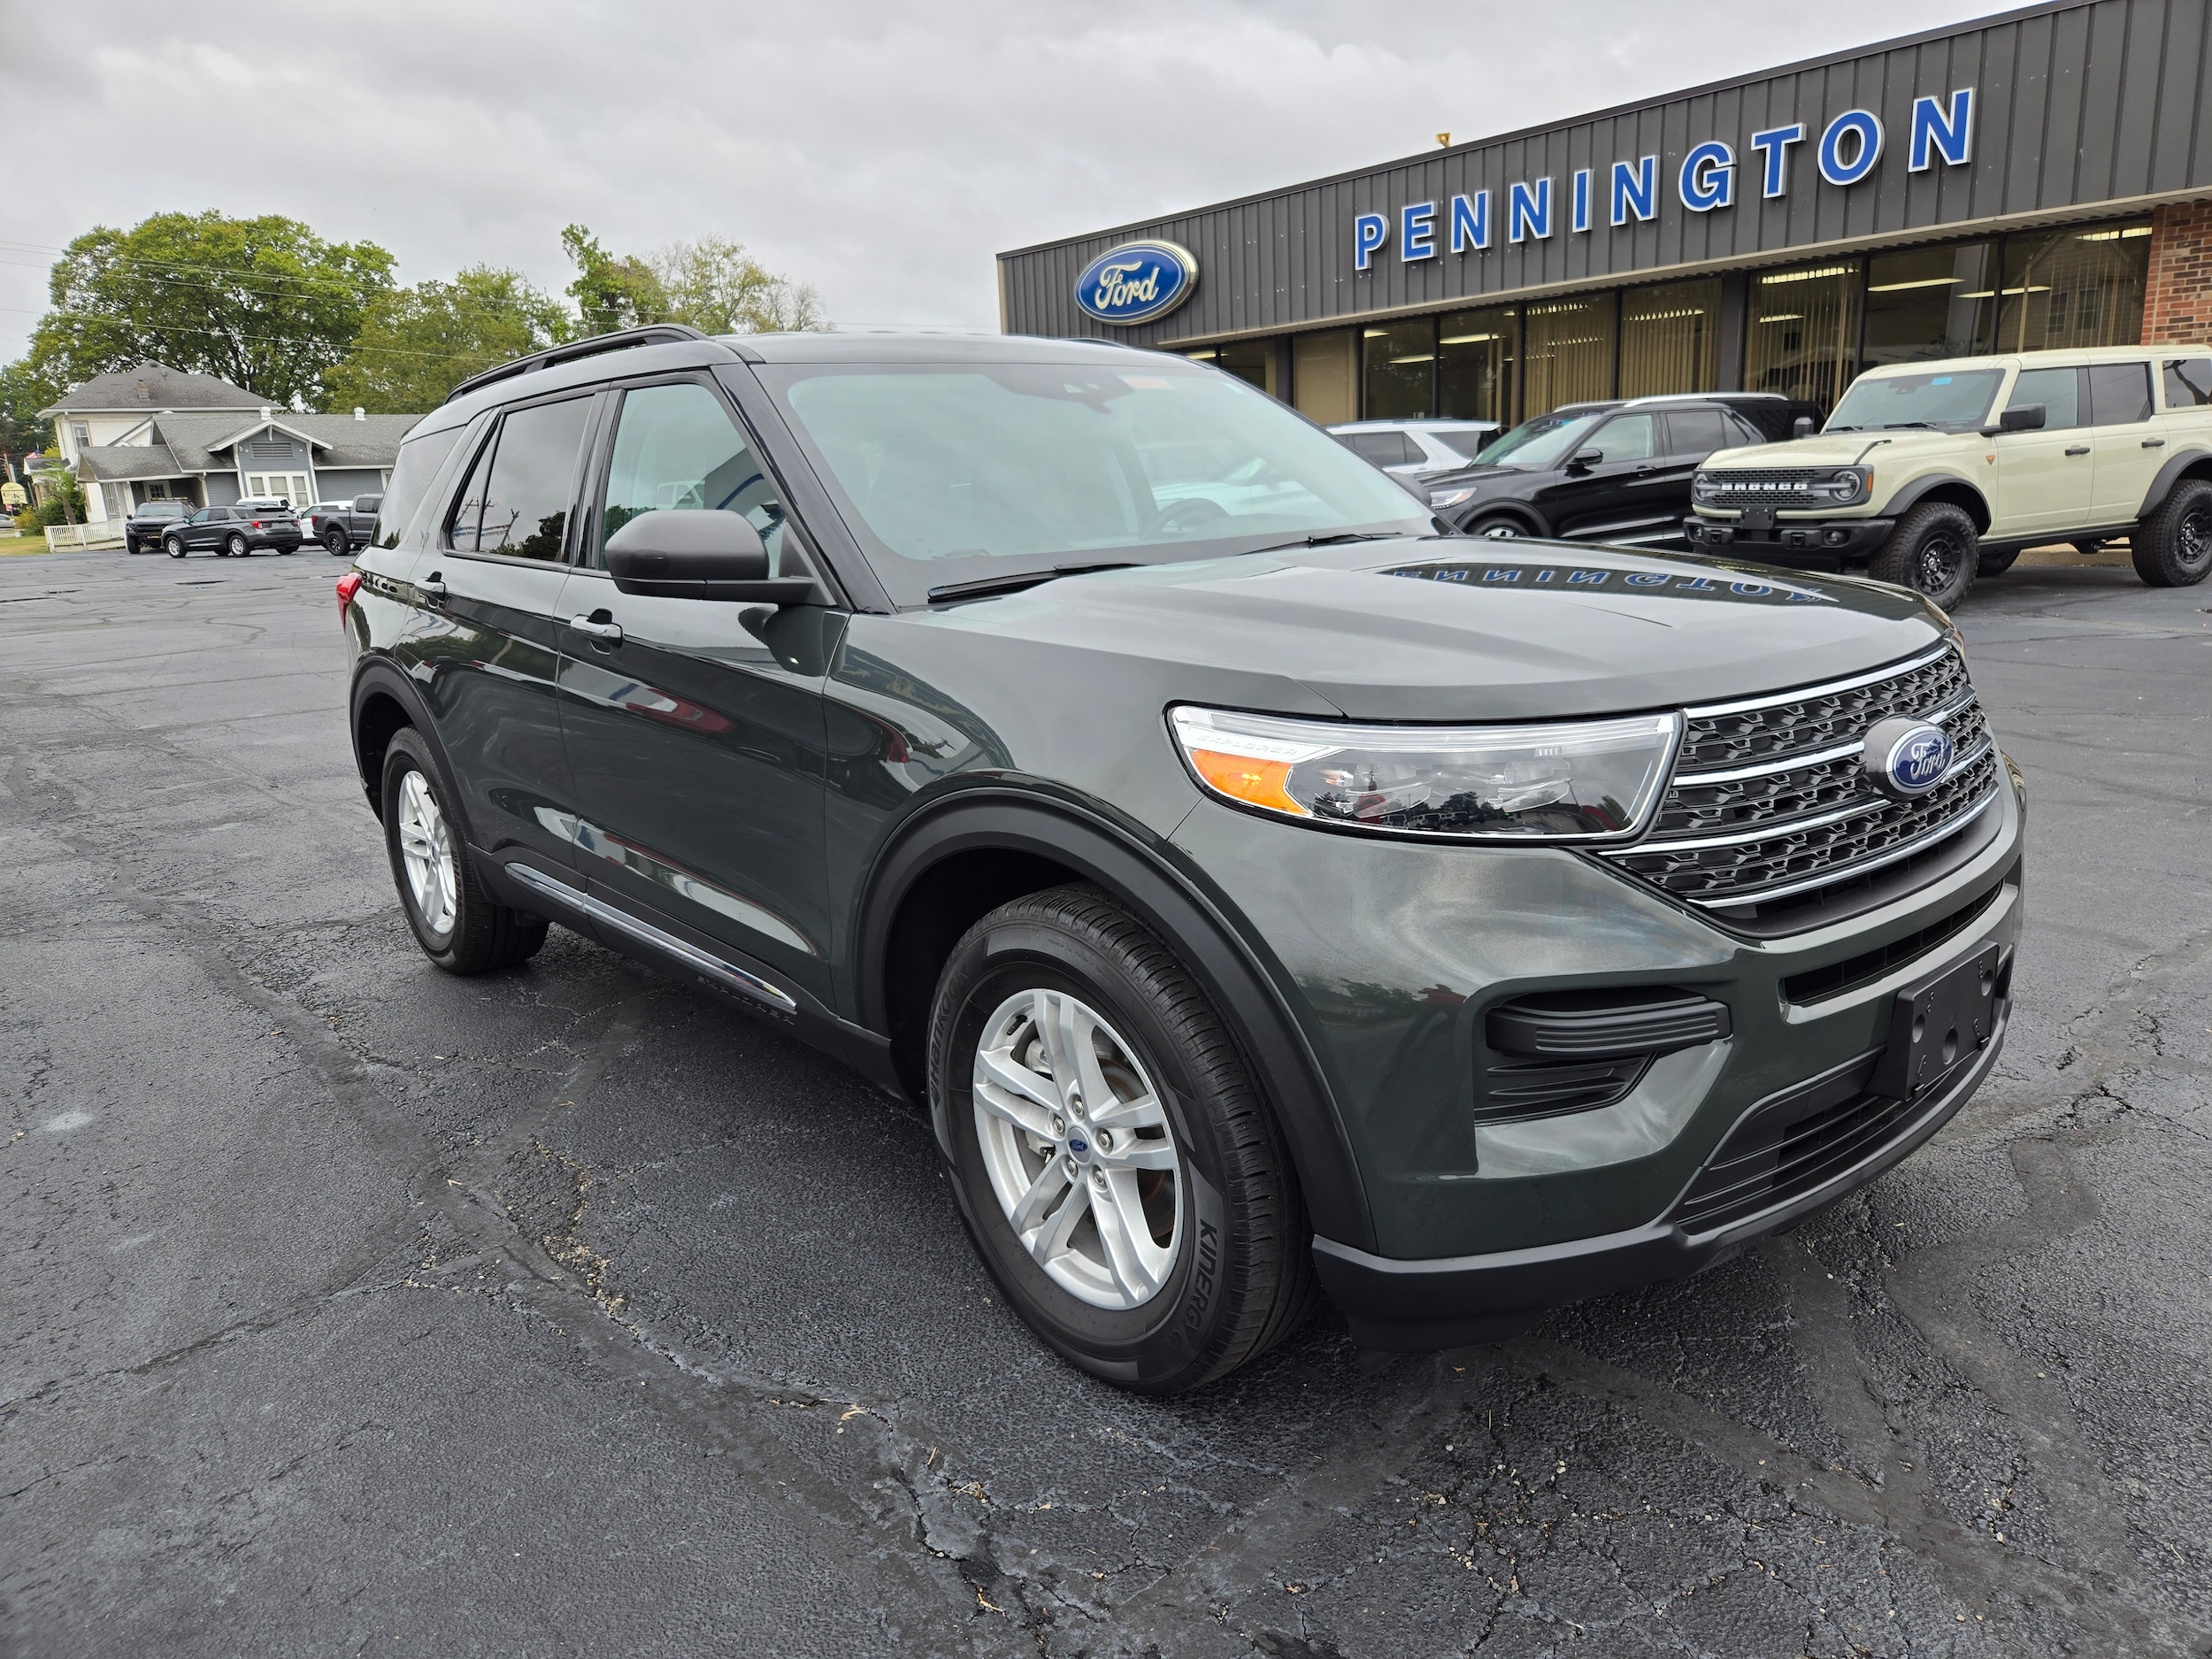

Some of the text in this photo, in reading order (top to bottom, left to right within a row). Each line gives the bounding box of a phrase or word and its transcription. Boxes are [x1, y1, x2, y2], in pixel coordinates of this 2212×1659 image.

[1355, 87, 1976, 271] PENNINGTON
[1094, 260, 1160, 310] Ford
[1721, 482, 1808, 491] BRONCO
[1198, 735, 1297, 755] EXPLORER
[1910, 738, 1947, 780] Ford
[1182, 1218, 1217, 1341] KINERGY
